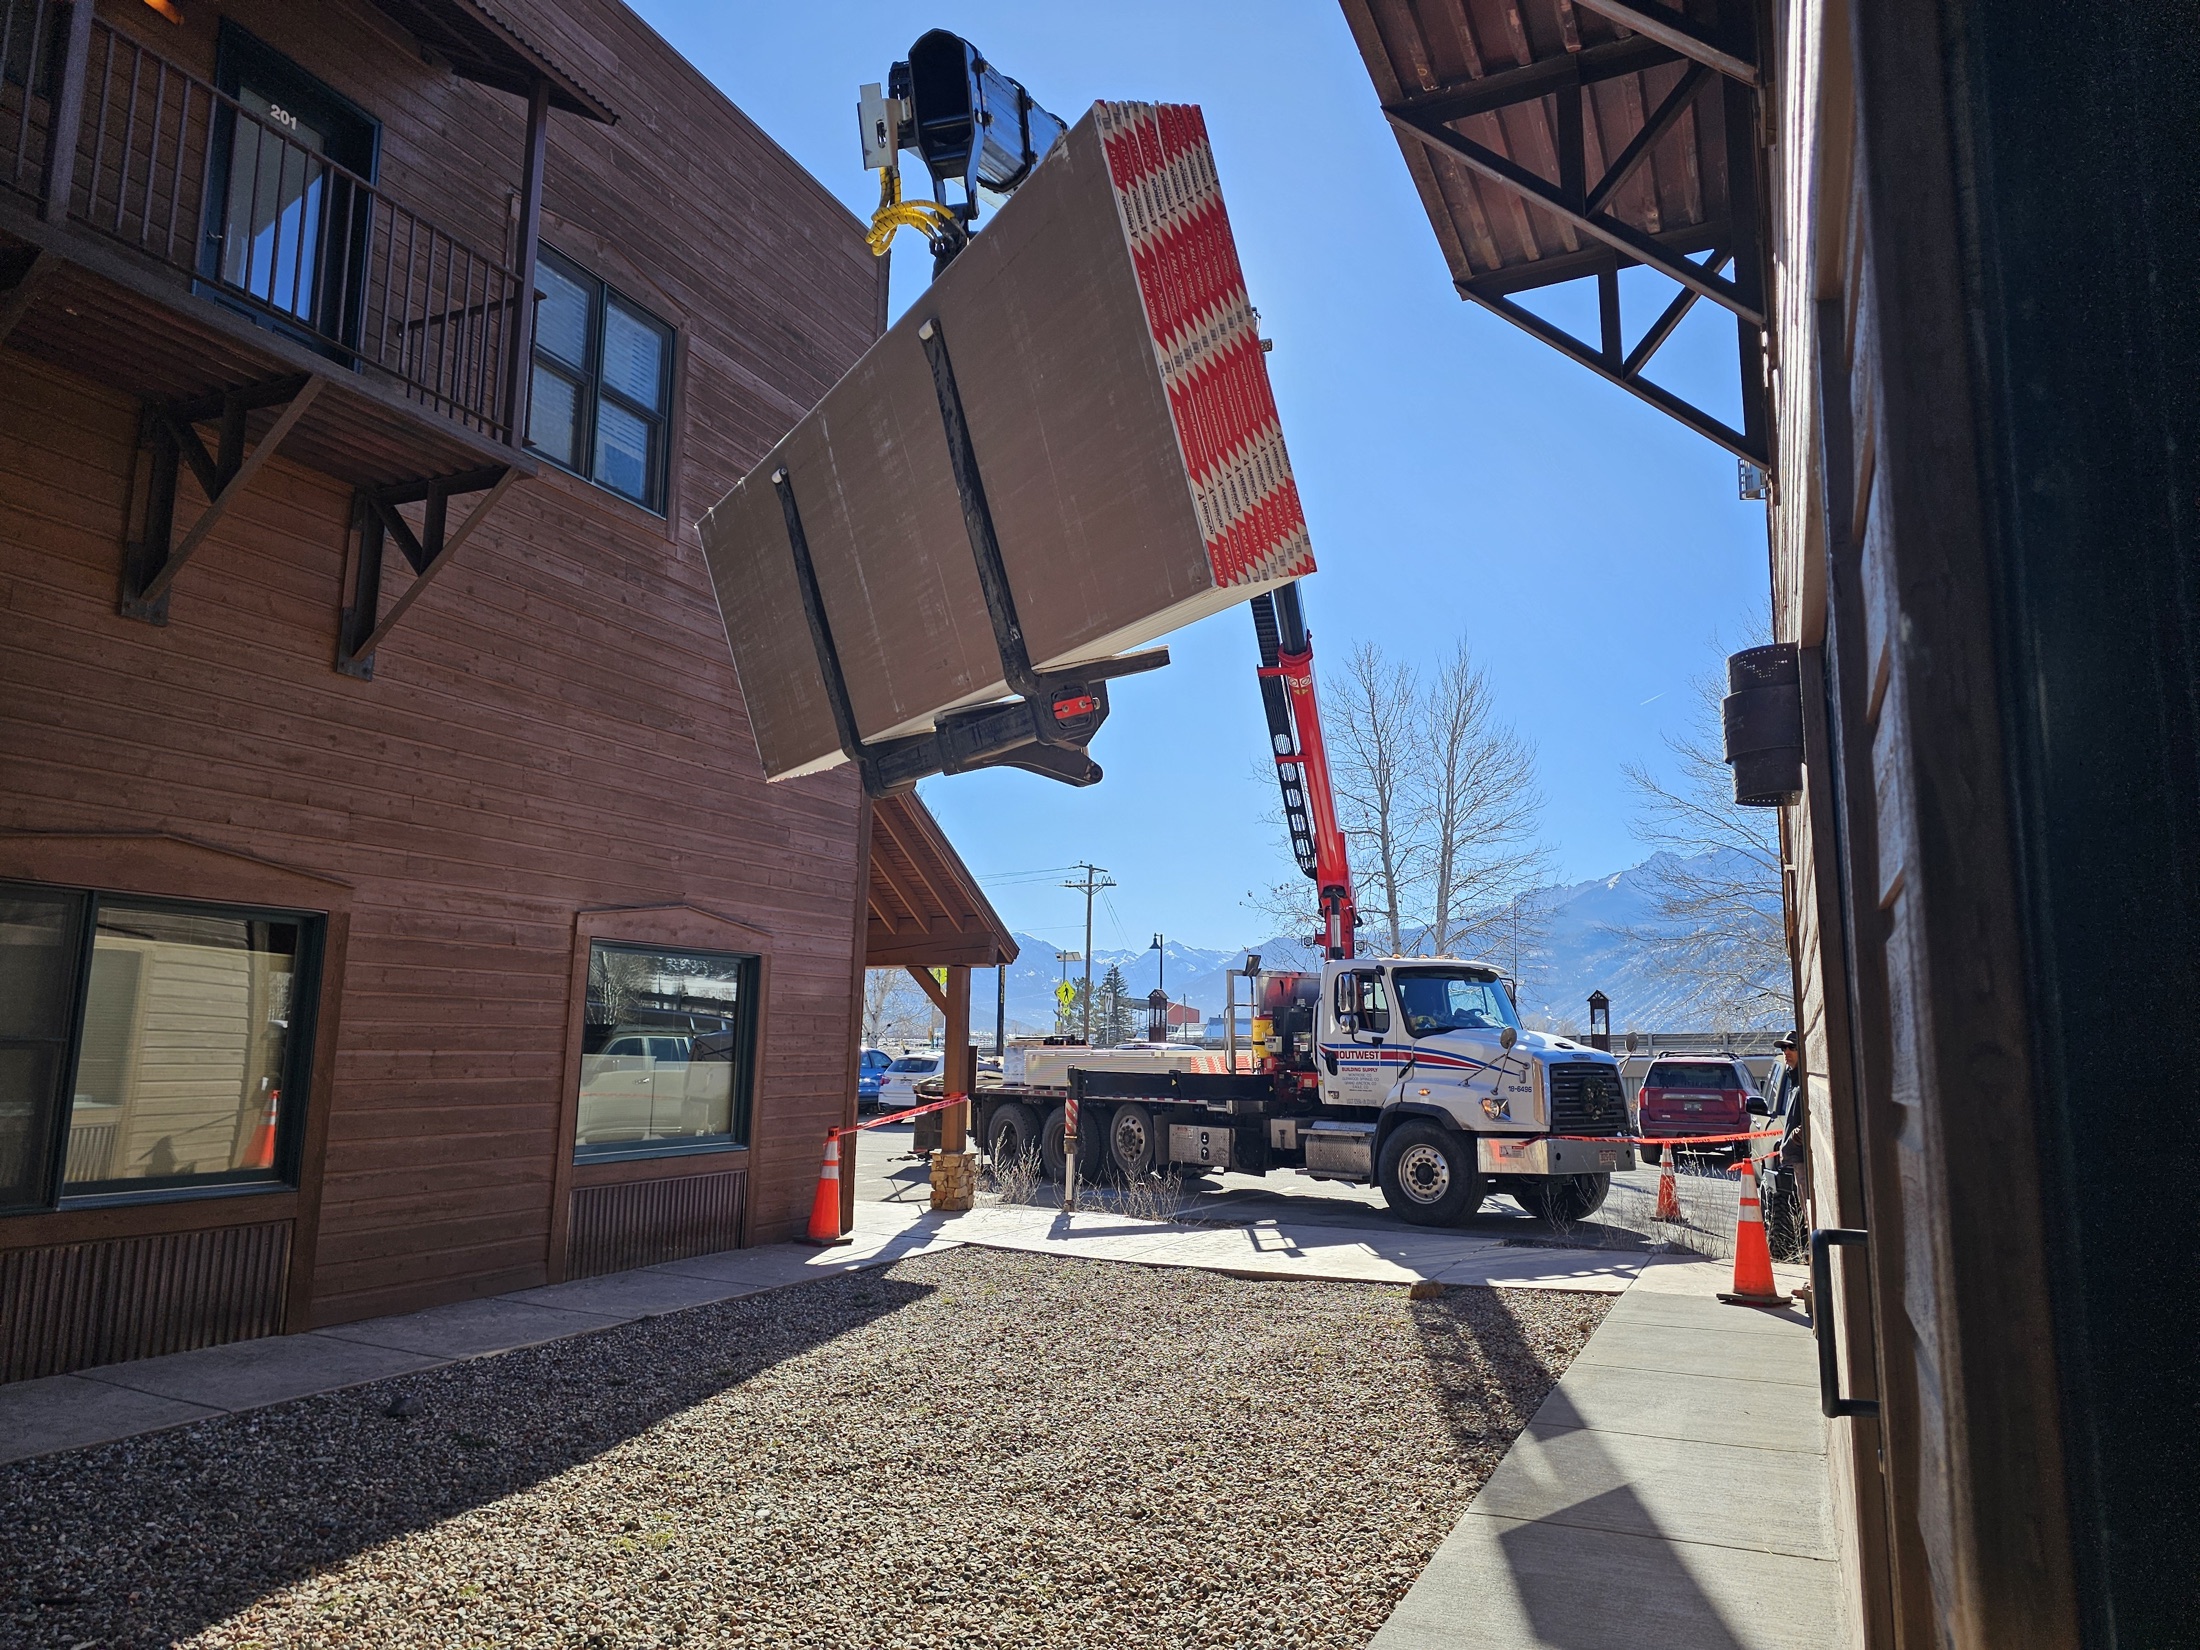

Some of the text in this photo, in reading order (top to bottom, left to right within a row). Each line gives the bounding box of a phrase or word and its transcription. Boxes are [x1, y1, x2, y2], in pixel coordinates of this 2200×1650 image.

[270, 104, 297, 130] 201
[1176, 161, 1190, 194] AMERICAN
[1185, 155, 1198, 188] AMERICAN
[1194, 150, 1207, 183] AMERICAN
[1202, 144, 1215, 178] AMERICAN
[1149, 177, 1163, 211] AMERICAN
[1158, 172, 1172, 206] AMERICAN
[1167, 166, 1181, 200] AMERICAN
[1120, 195, 1134, 229] AMERICAN
[1130, 190, 1144, 224] AMERICAN
[1140, 183, 1154, 218] AMERICAN
[1188, 245, 1197, 262] TYPE
[1197, 240, 1207, 257] TYPE
[1205, 234, 1215, 251] TYPE
[1161, 264, 1171, 281] TYPE
[1170, 257, 1179, 274] TYPE
[1179, 251, 1189, 269] TYPE
[1201, 259, 1215, 292] FIREBLOC
[1209, 253, 1223, 285] FIREBLOC
[1141, 276, 1151, 293] TYPE
[1151, 270, 1161, 288] TYPE
[1174, 276, 1188, 309] FIREBLOC
[1183, 271, 1198, 303] FIREBLOC
[1192, 265, 1206, 297] FIREBLOC
[1145, 295, 1160, 329] FIREBLOC
[1155, 290, 1170, 323] FIREBLOC
[1165, 283, 1180, 316] FIREBLOC
[1194, 392, 1202, 406] Panel
[1238, 360, 1246, 374] Panel
[1248, 399, 1258, 422] interiores
[1246, 353, 1254, 367] Panel
[1256, 392, 1266, 415] interiores
[1175, 405, 1183, 420] Panel
[1197, 406, 1205, 417] tipo
[1203, 385, 1211, 399] Panel
[1213, 424, 1224, 448] interiores
[1212, 379, 1220, 393] Panel
[1222, 417, 1232, 441] interiores
[1221, 372, 1229, 386] Panel
[1231, 411, 1241, 434] interiores
[1239, 405, 1250, 428] interiores
[1178, 419, 1186, 430] tipo
[1185, 399, 1193, 413] Panel
[1195, 438, 1206, 462] interiores
[1185, 445, 1196, 469] interiores
[1204, 431, 1215, 455] interiores
[1279, 439, 1291, 472] AMERICAN
[1255, 459, 1267, 492] AMERICAN
[1263, 452, 1275, 485] AMERICAN
[1271, 445, 1284, 479] AMERICAN
[1228, 479, 1241, 513] AMERICAN
[1238, 472, 1250, 506] AMERICAN
[1246, 466, 1259, 499] AMERICAN
[1201, 500, 1214, 535] AMERICAN
[1211, 494, 1224, 528] AMERICAN
[1220, 486, 1232, 520] AMERICAN
[1340, 1050, 1380, 1060] OUTWEST
